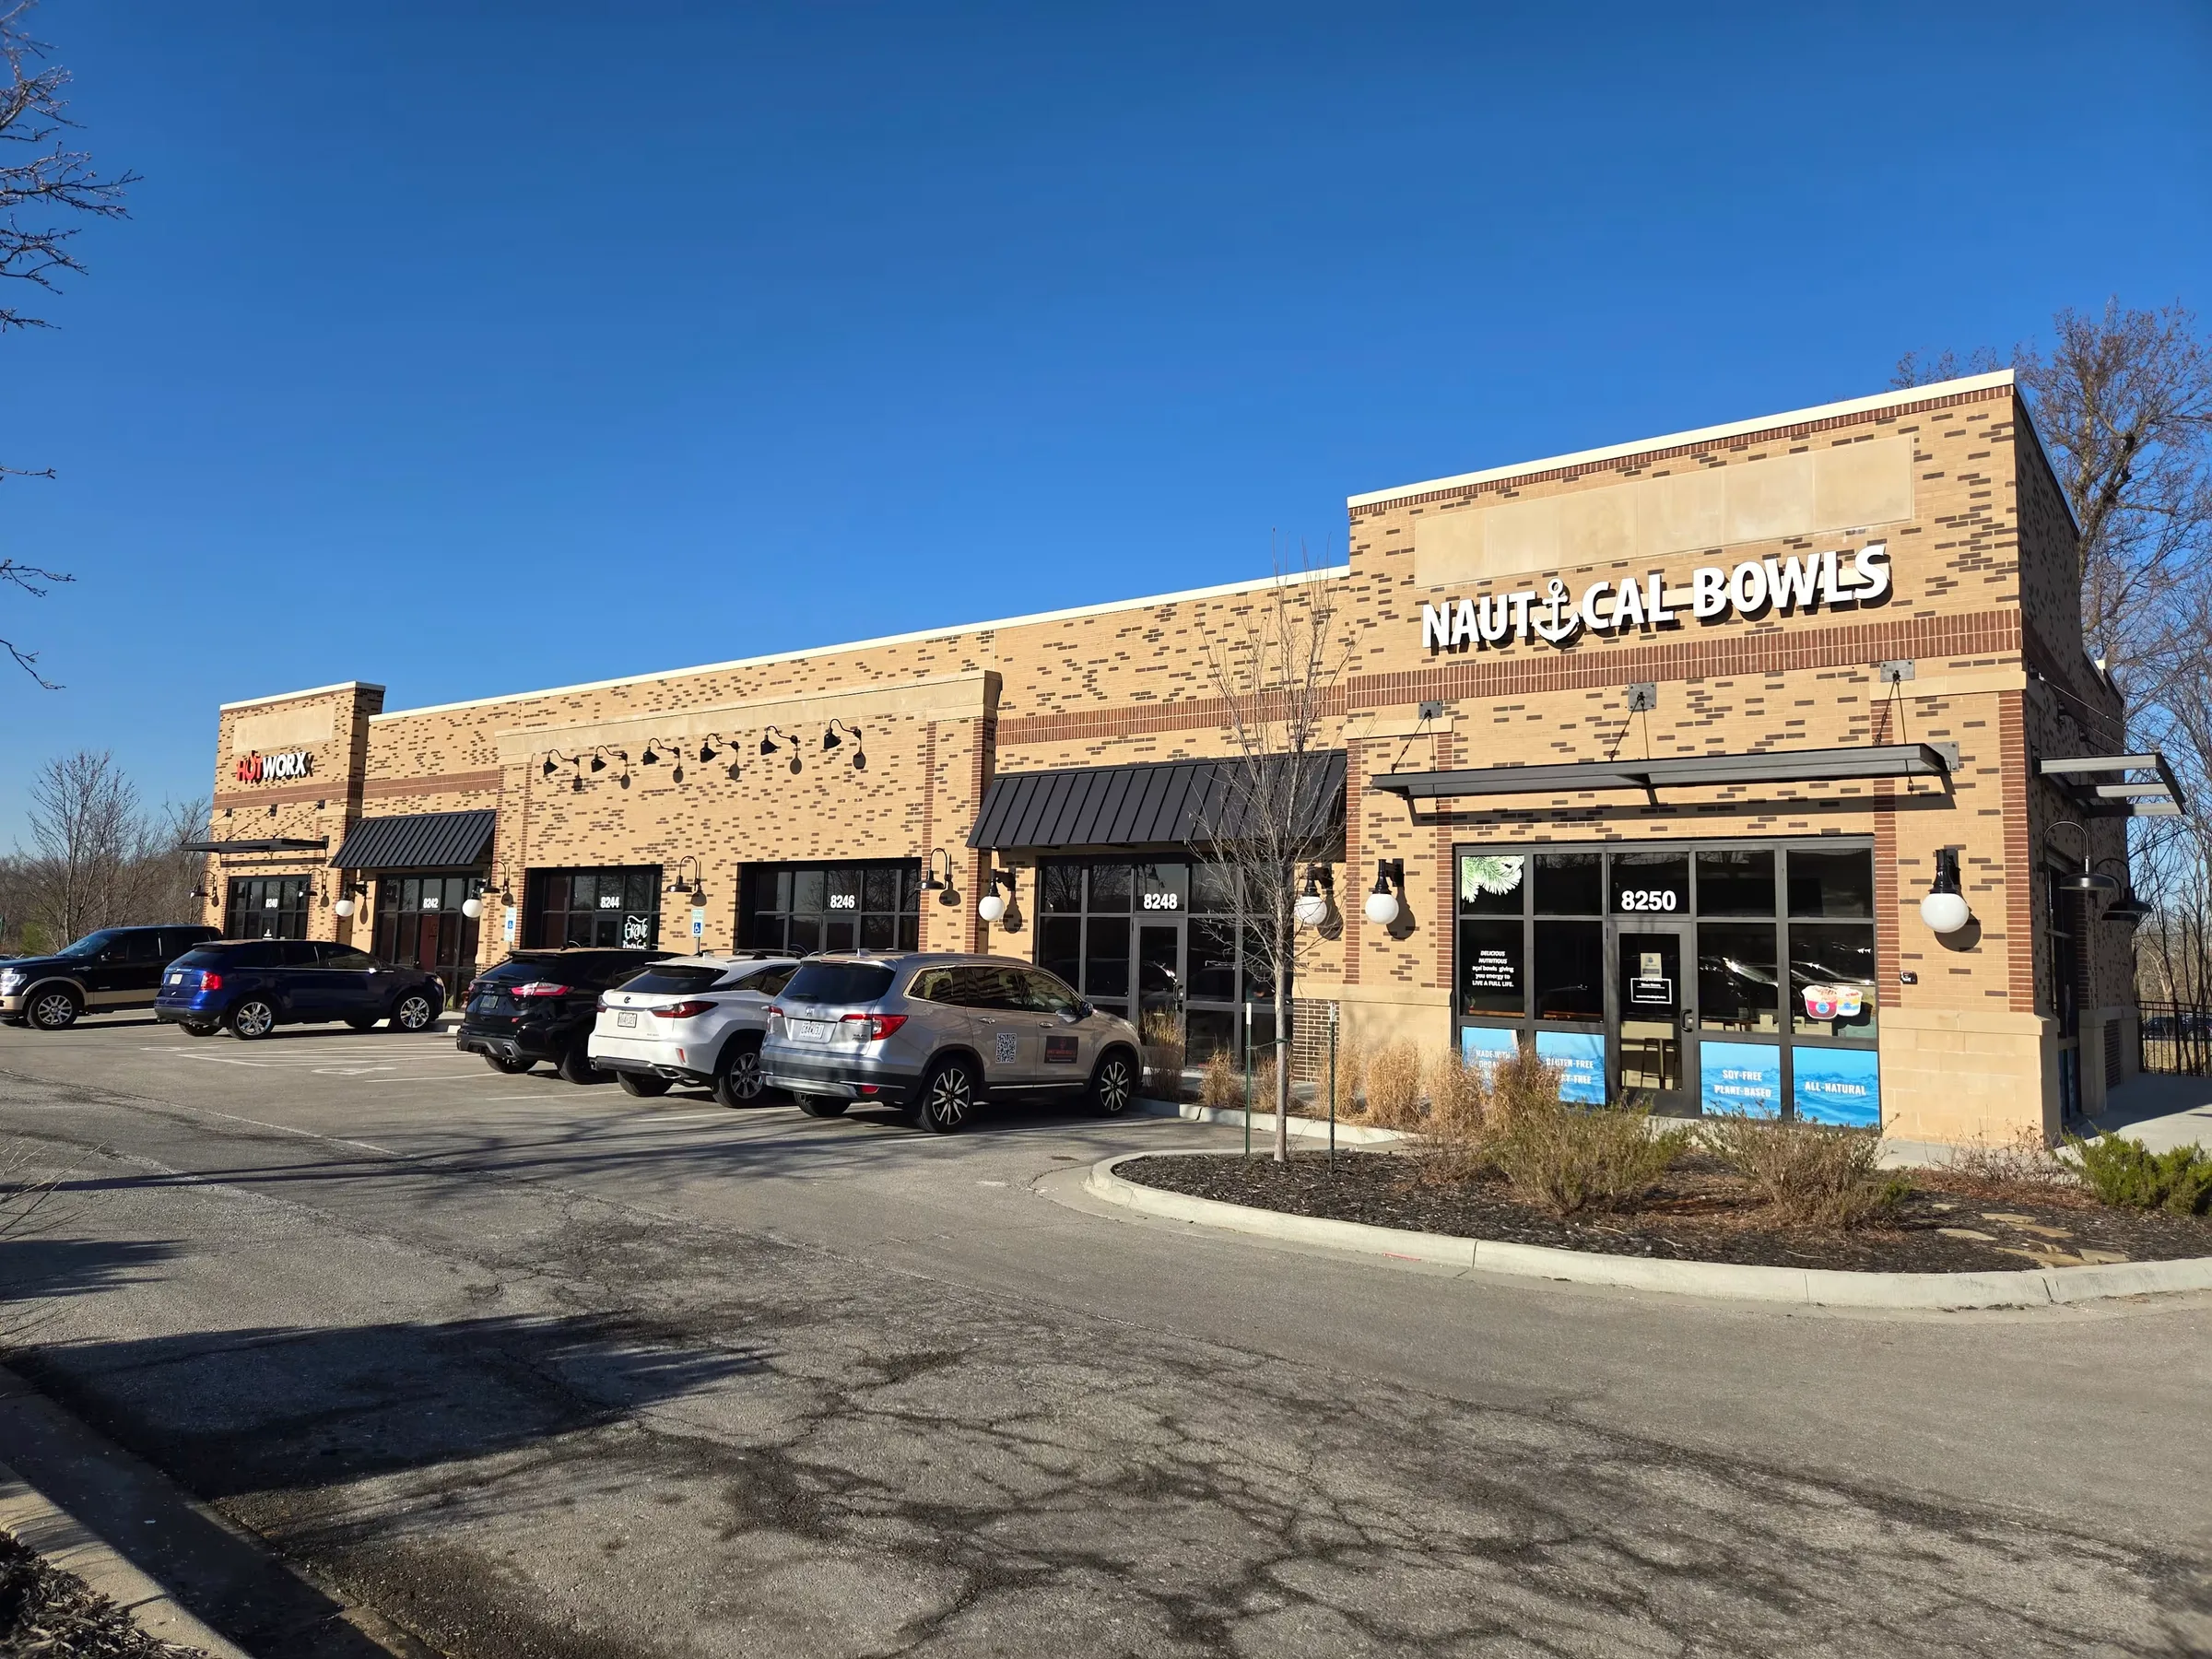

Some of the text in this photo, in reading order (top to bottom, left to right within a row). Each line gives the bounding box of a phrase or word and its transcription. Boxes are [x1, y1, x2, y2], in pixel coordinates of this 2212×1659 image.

[1692, 545, 1891, 619] BOWLS
[265, 898, 278, 909] 8240
[423, 898, 439, 909] 8242
[600, 897, 620, 909] 8244
[830, 894, 855, 909] 8246
[1143, 893, 1178, 910] 8248
[1621, 890, 1677, 911] 8250
[1476, 1050, 1493, 1059] MADE
[1722, 1069, 1763, 1082] SOY-FREE
[1714, 1084, 1771, 1098] PLANT-BASED
[1804, 1081, 1866, 1095] ALL-NATURAL
